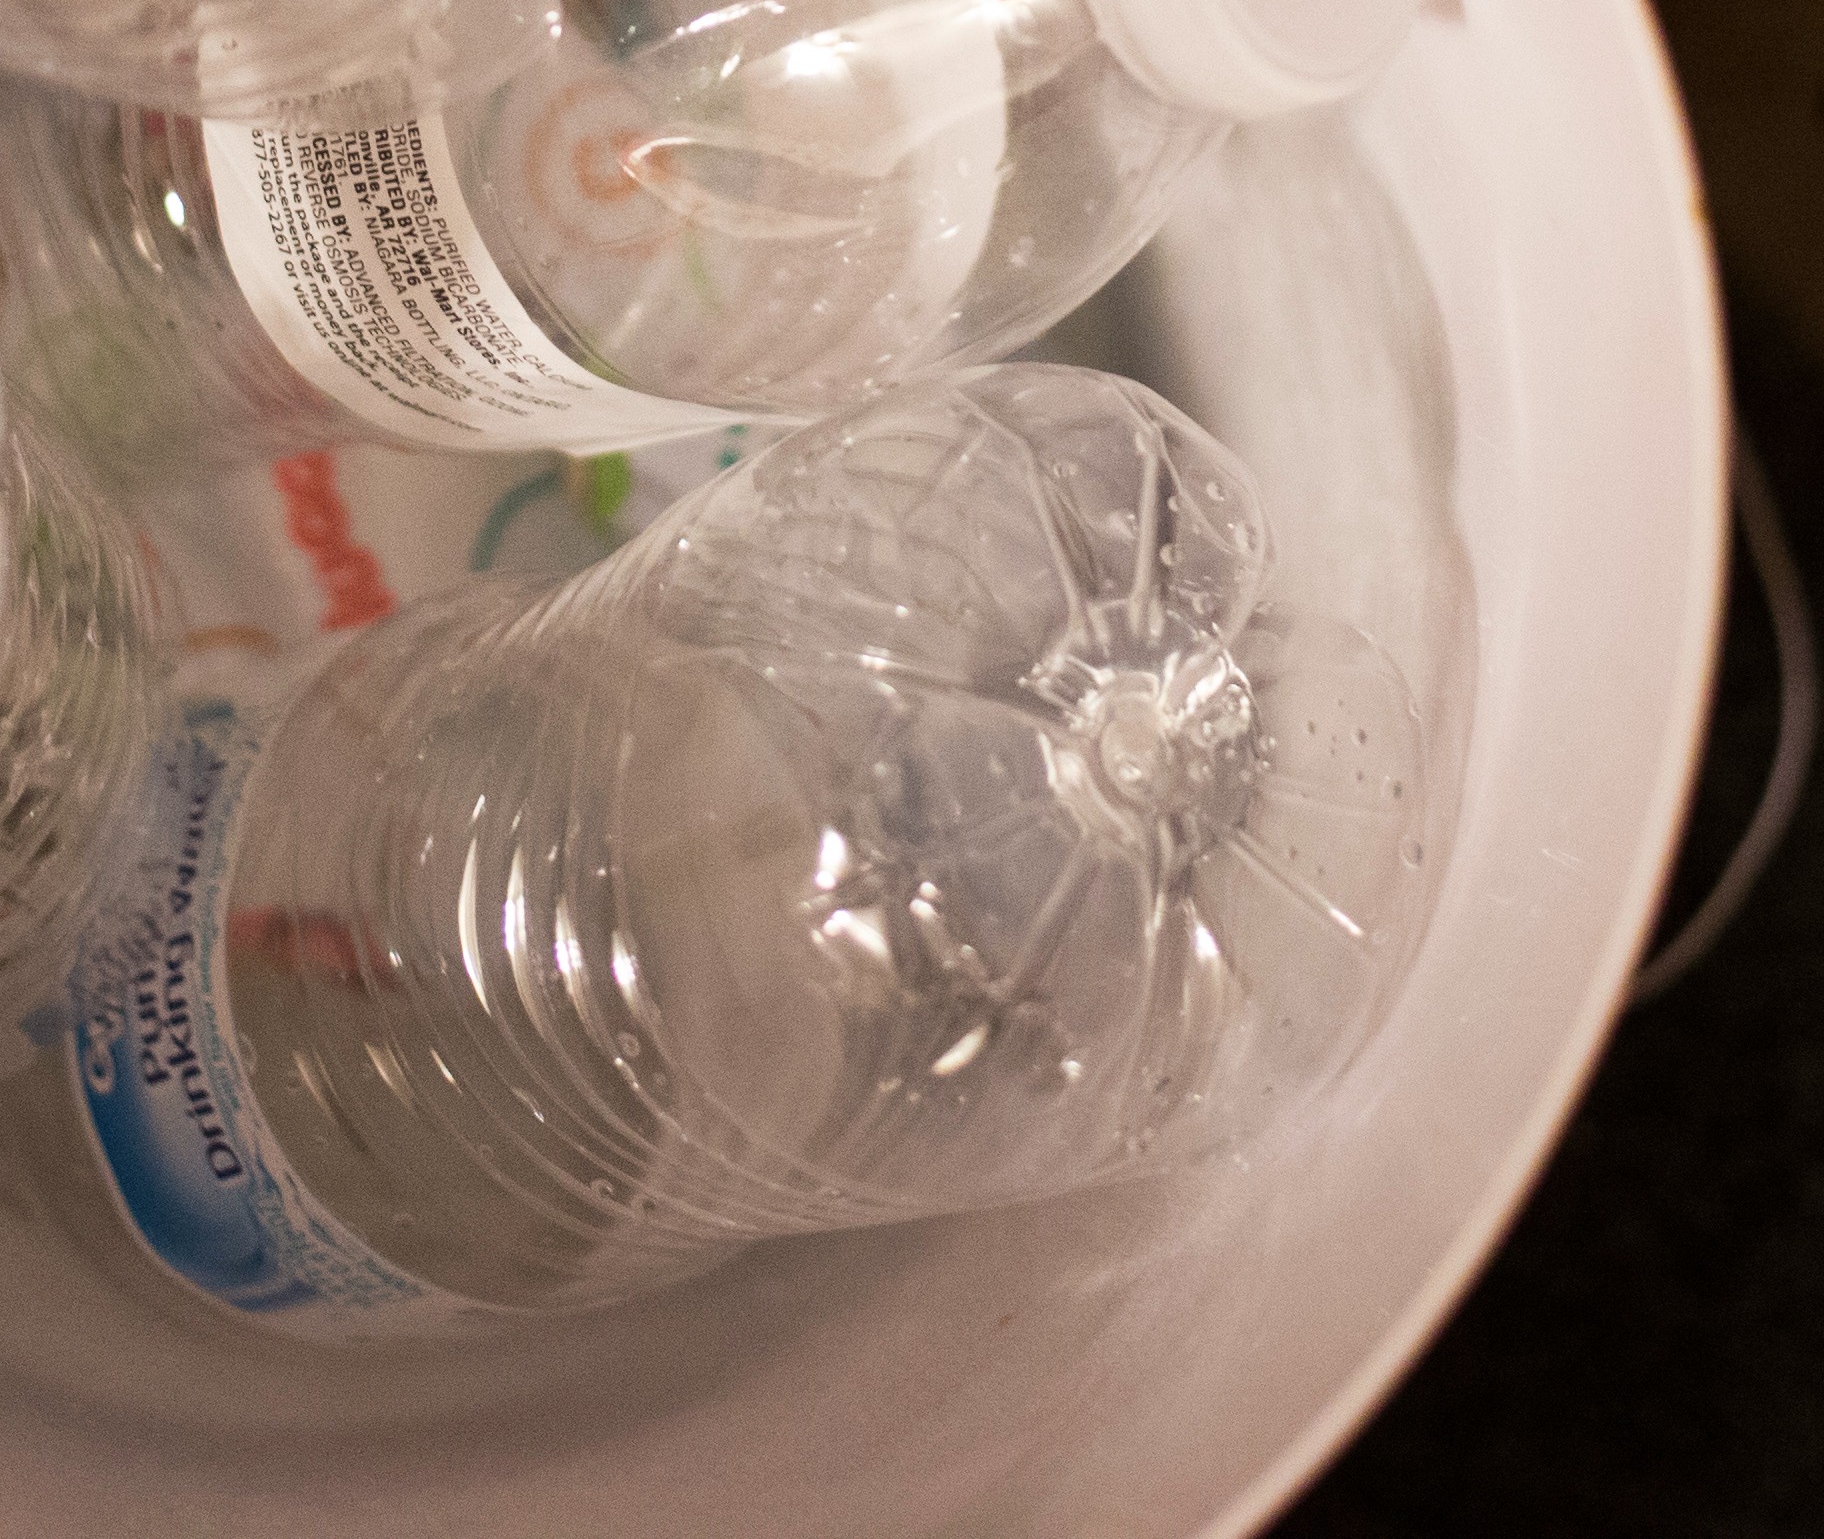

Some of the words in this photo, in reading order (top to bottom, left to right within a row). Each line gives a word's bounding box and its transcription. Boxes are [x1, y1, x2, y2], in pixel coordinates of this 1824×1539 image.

[268, 137, 305, 256] replacement
[300, 259, 314, 279] or
[309, 282, 346, 338] money
[288, 172, 302, 204] the
[295, 209, 331, 284] package
[327, 288, 353, 320] and
[347, 323, 371, 347] the
[298, 146, 330, 229] REVERSE
[323, 235, 369, 315] OSMOSIS
[312, 131, 342, 209] CESSED
[331, 215, 351, 243] BY:
[344, 249, 401, 335] ADVANCED
[354, 182, 372, 211] BY:
[365, 217, 408, 295] NIAGARA
[376, 205, 395, 230] AR
[389, 234, 422, 287] 72716
[397, 217, 418, 246] BY:
[412, 248, 462, 324] Wal-Mart
[407, 189, 445, 262] SODIUM
[433, 217, 481, 295] PURIFIED
[284, 260, 298, 279] or
[293, 283, 316, 318] visit
[313, 321, 331, 339] us
[165, 932, 244, 1179] Drinking
